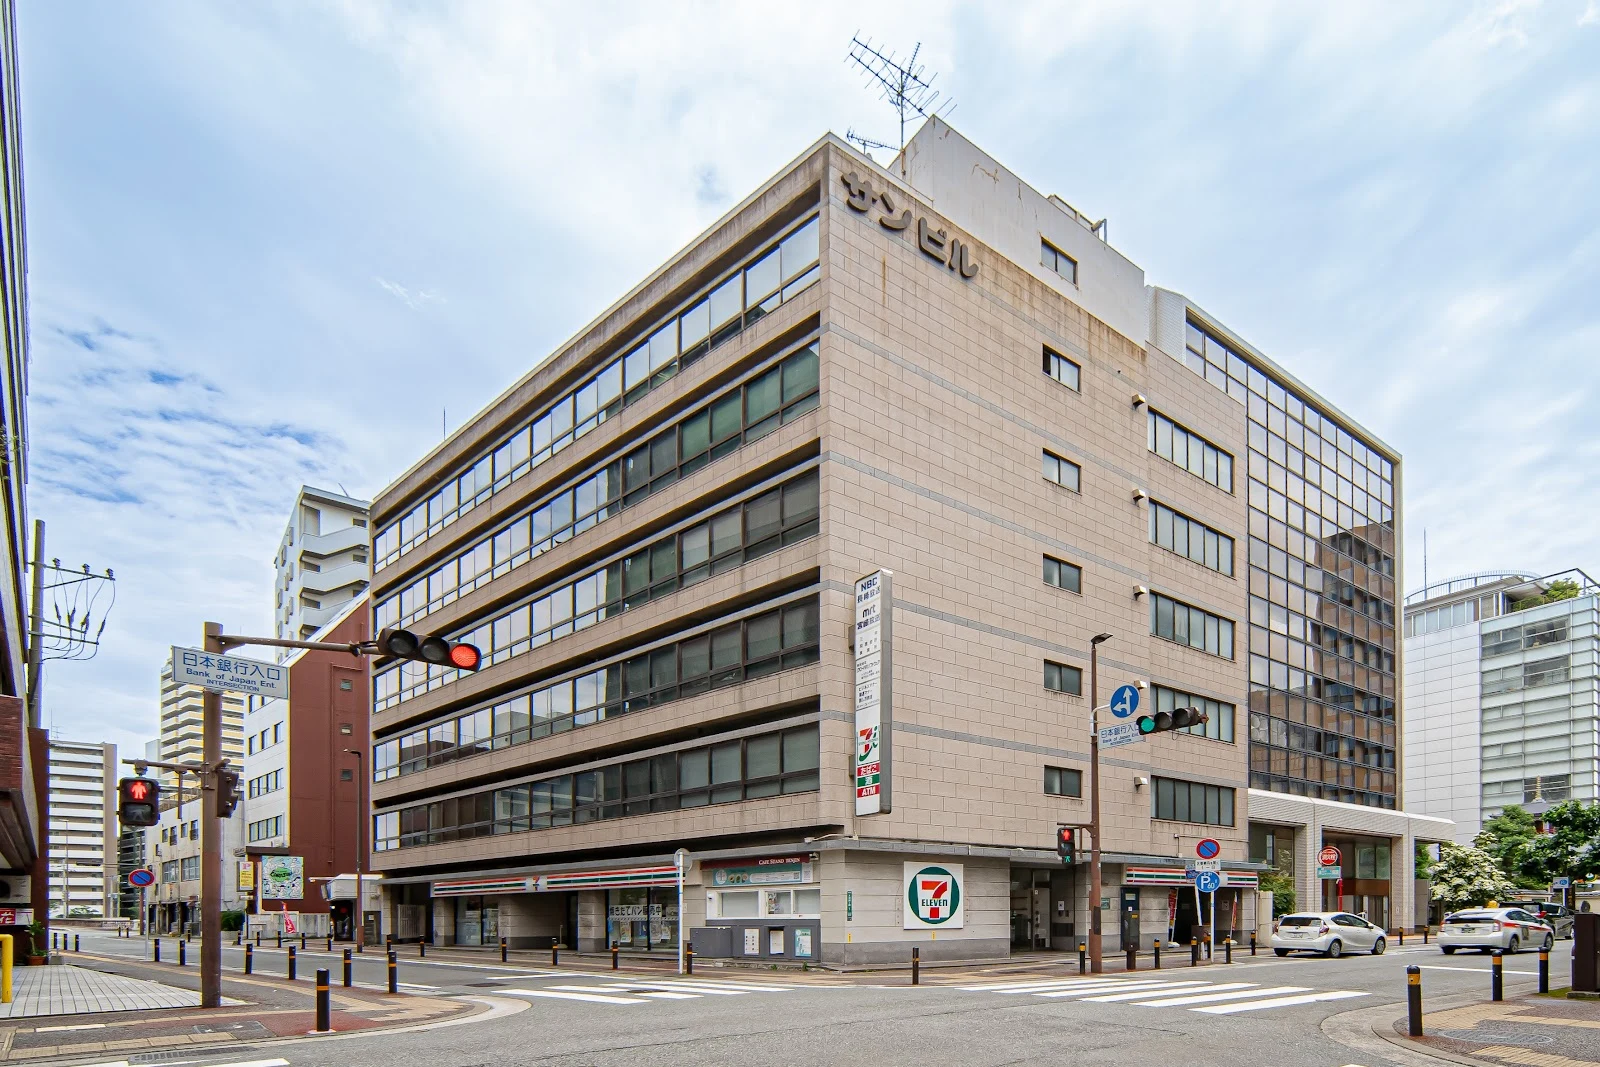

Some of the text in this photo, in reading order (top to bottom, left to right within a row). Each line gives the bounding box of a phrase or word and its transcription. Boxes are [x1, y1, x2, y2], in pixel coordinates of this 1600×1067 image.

[840, 171, 979, 279] サンビル
[861, 577, 878, 592] NBC
[862, 604, 876, 618] mrt
[183, 652, 280, 681] 日本銀行入口
[186, 667, 210, 678] Bank
[229, 675, 256, 686] Japan
[260, 680, 277, 689] Ent.
[206, 679, 260, 692] INTERSECTION
[861, 786, 876, 797] ATM
[1201, 875, 1210, 889] P
[922, 881, 947, 918] 7
